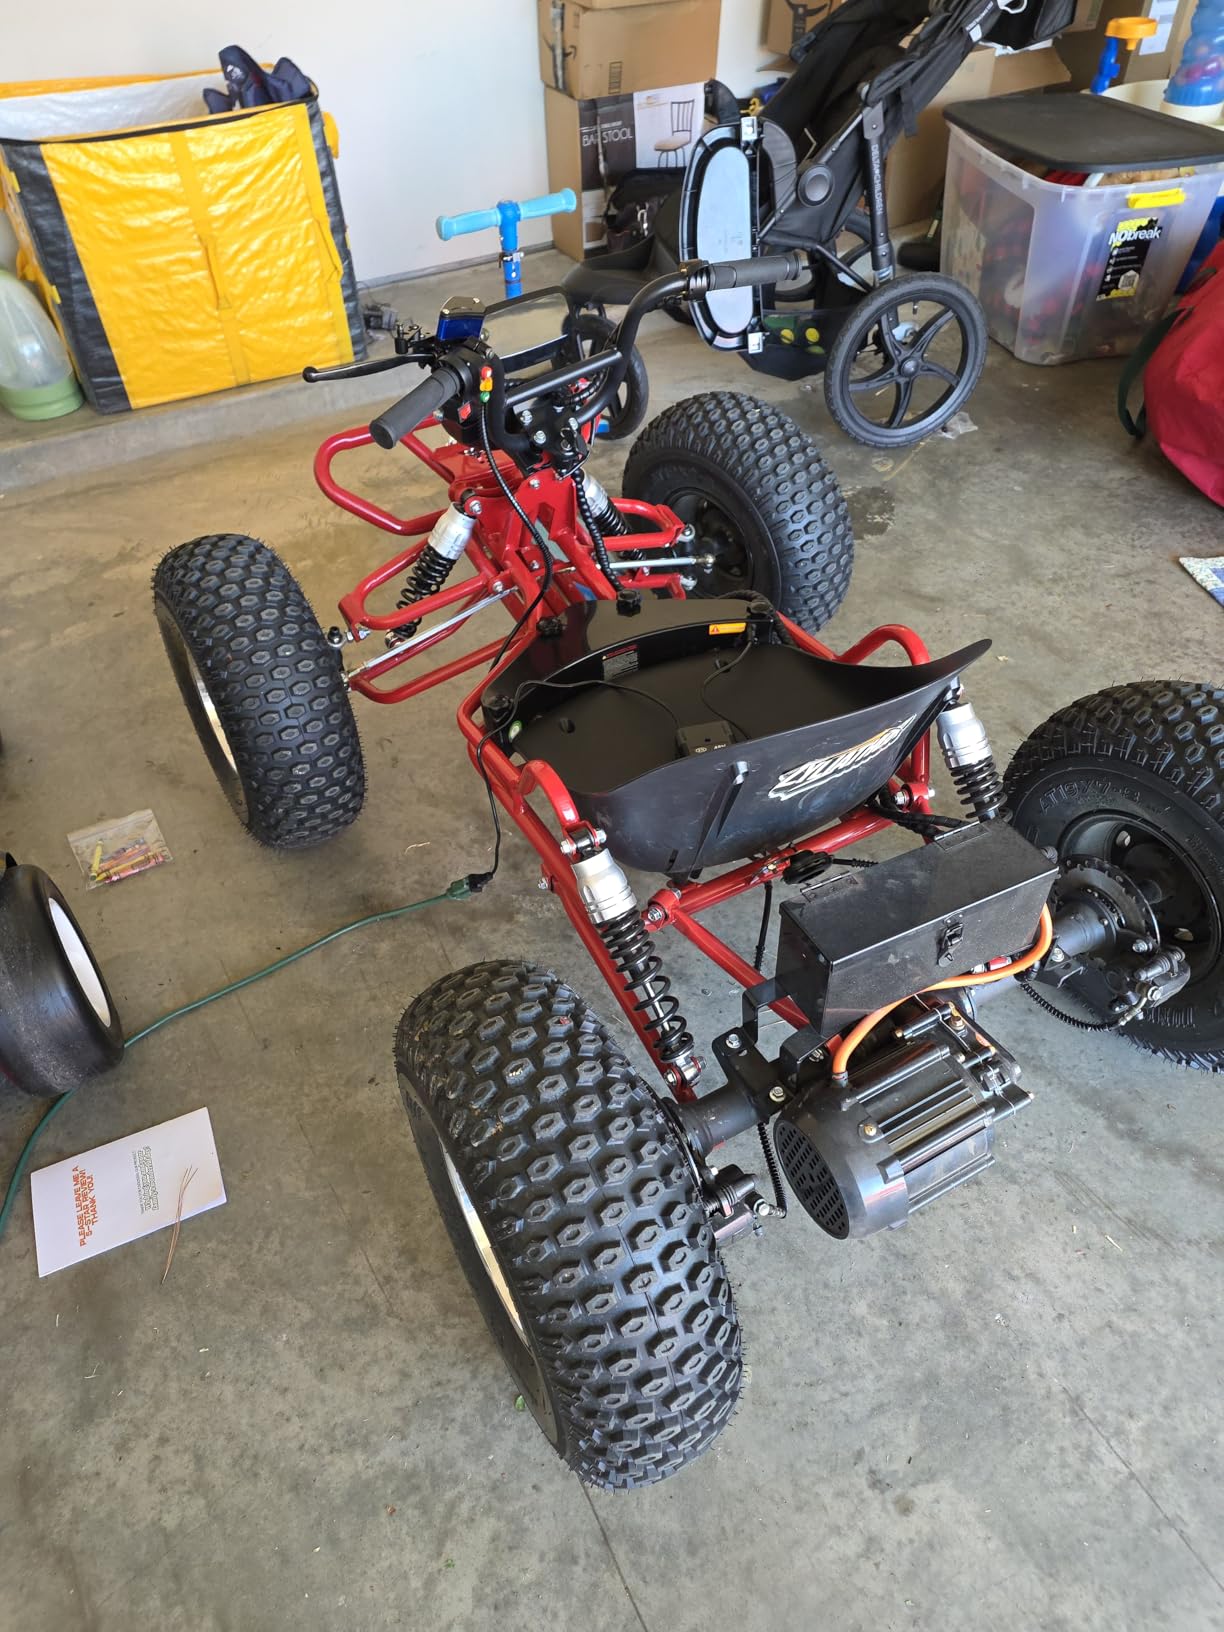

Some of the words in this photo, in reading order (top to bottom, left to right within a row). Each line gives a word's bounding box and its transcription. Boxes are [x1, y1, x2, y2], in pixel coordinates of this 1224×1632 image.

[602, 128, 633, 143] STOOL
[871, 144, 880, 170] DELTA
[874, 174, 884, 215] CHILDREN
[72, 1173, 79, 1186] ME
[82, 1204, 92, 1236] 5-STAR
[90, 1195, 98, 1225] THANK
[77, 1215, 86, 1246] PLEASE
